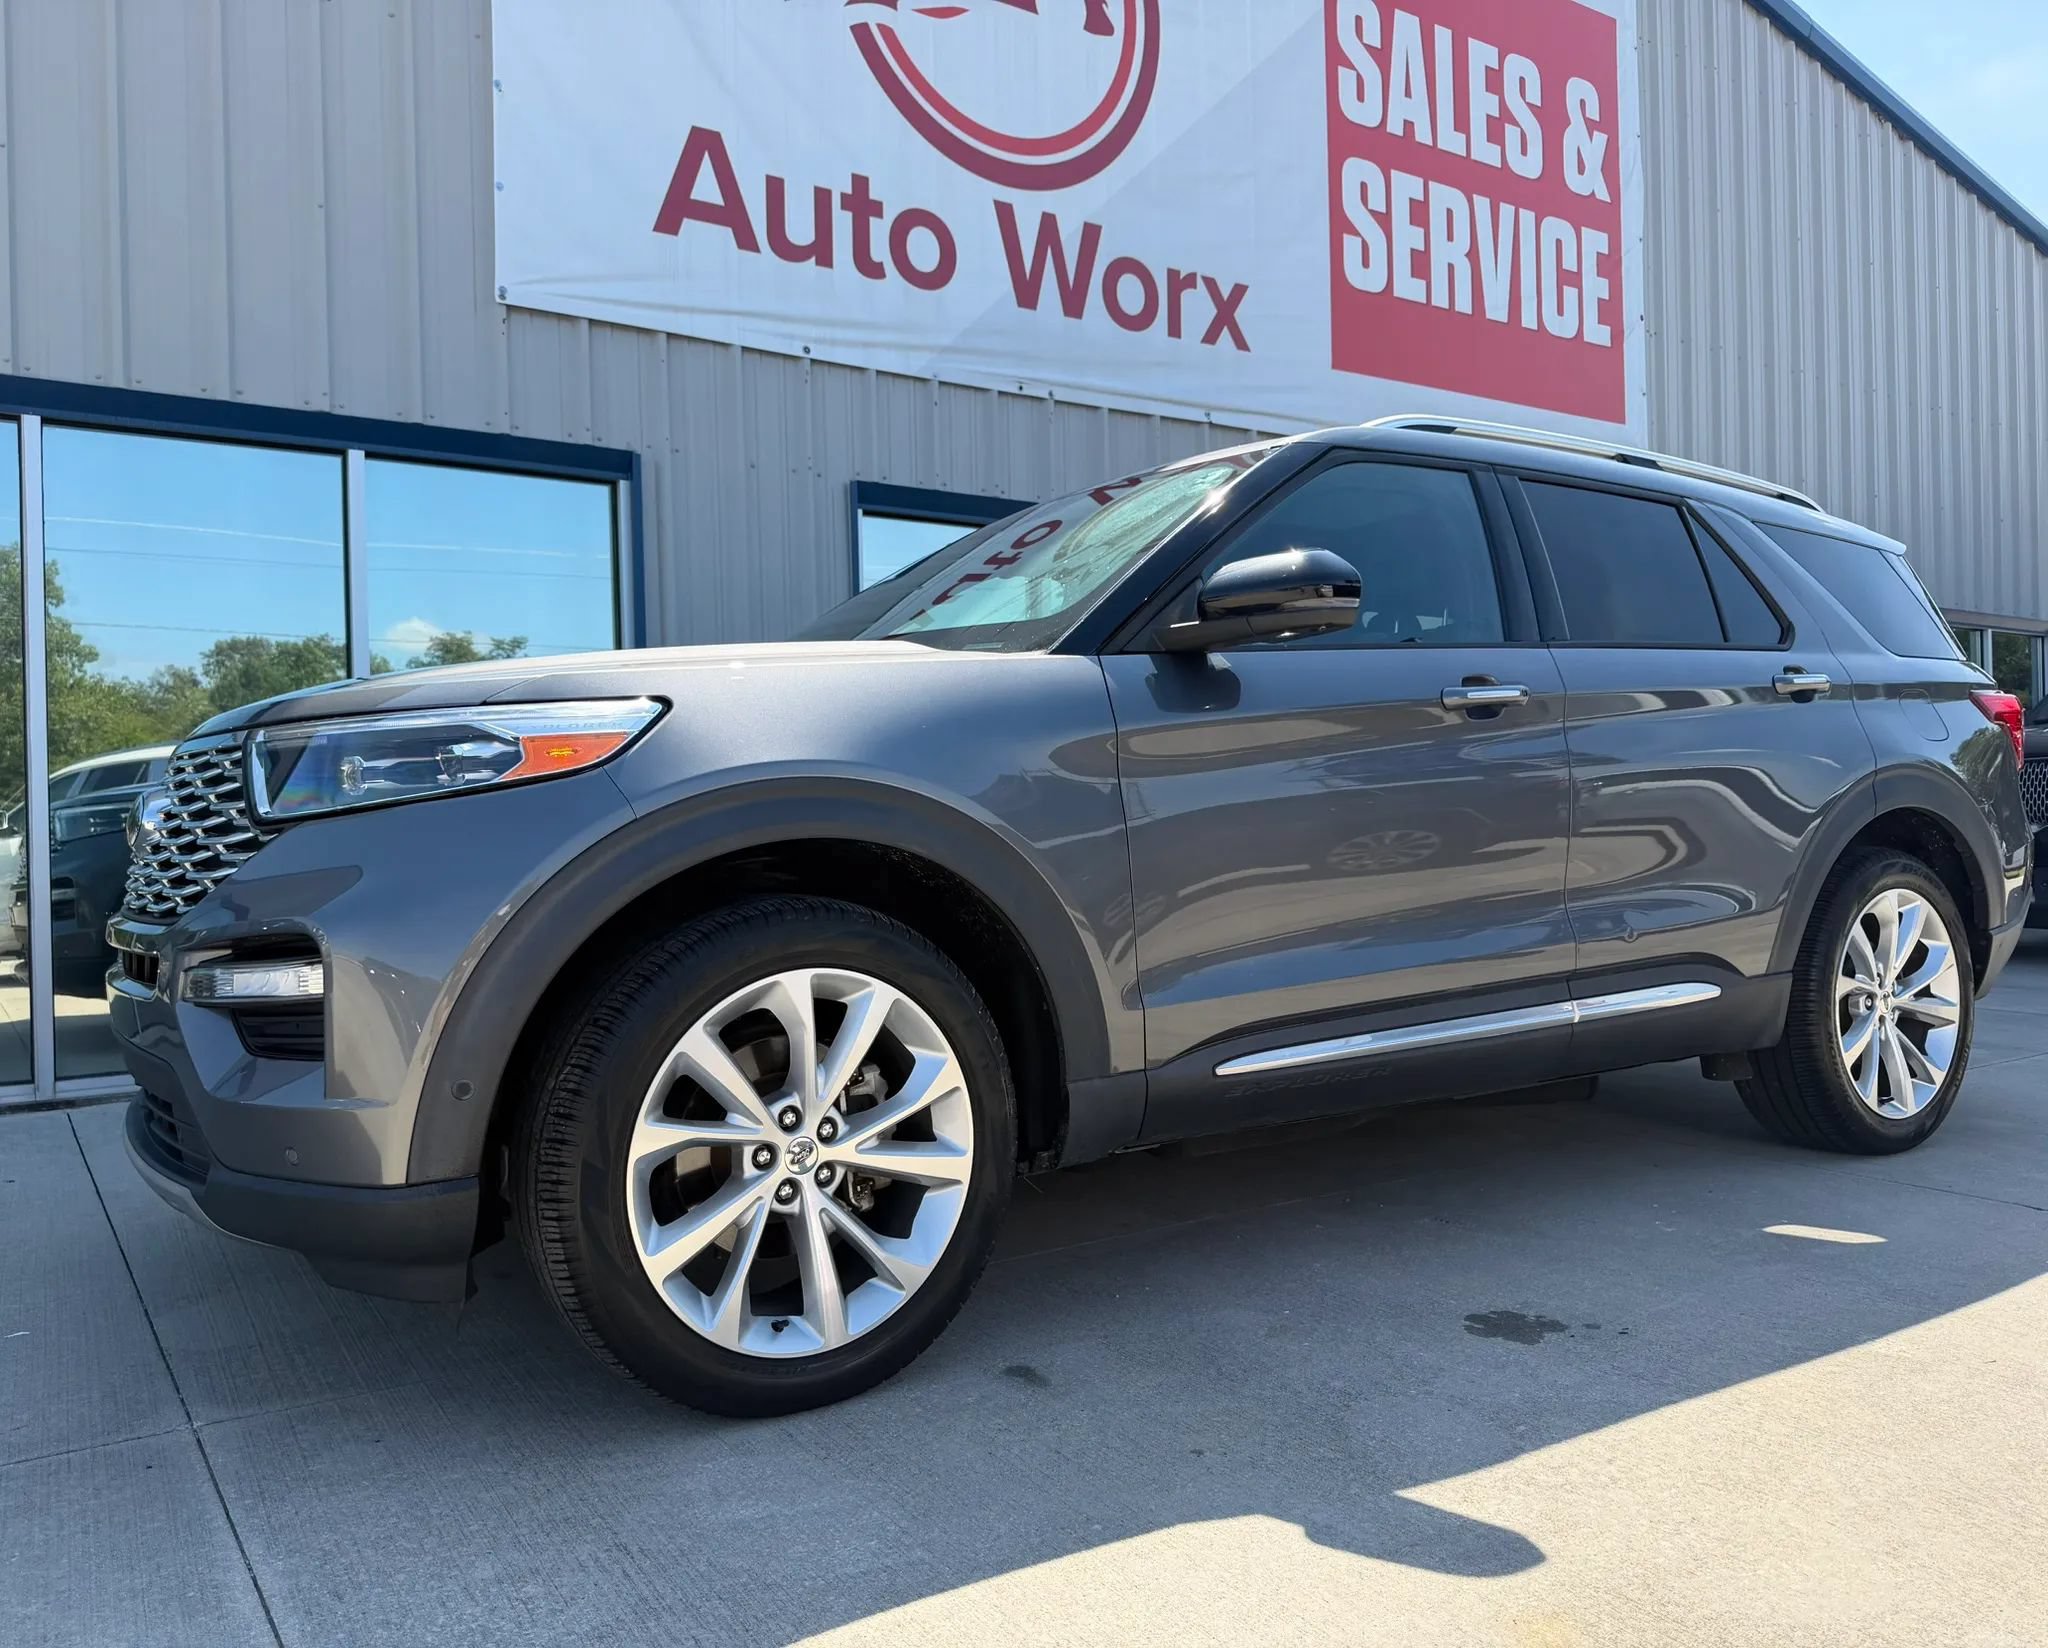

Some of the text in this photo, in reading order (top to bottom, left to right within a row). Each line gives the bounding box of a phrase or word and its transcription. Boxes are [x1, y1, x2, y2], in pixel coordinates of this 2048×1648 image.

[1336, 0, 1612, 203] SALES &
[652, 124, 1251, 352] Auto Worx
[1341, 156, 1612, 347] SERVICE
